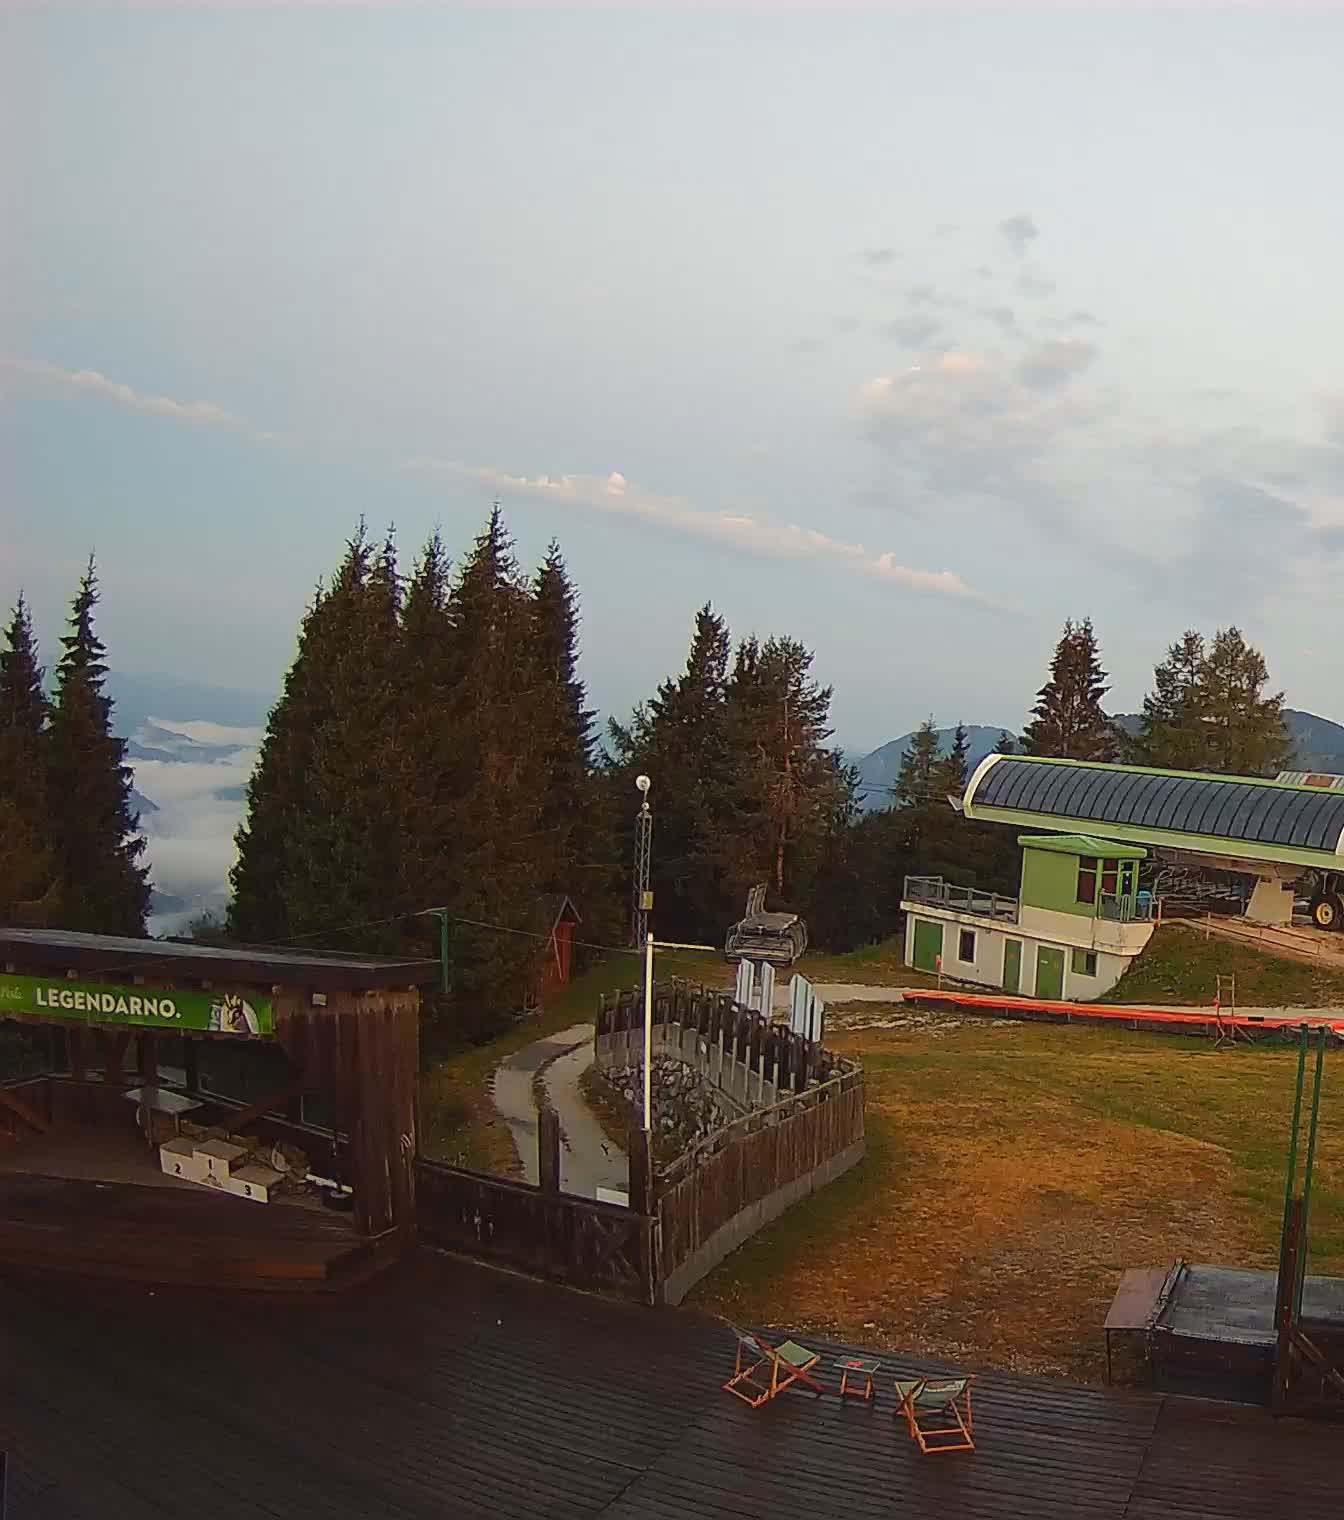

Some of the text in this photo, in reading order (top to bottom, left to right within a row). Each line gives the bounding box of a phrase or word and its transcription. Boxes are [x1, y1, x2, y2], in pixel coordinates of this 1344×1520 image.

[36, 987, 183, 1020] LEGENDARNO.
[174, 1163, 183, 1175] 2
[244, 1184, 252, 1197] 3
